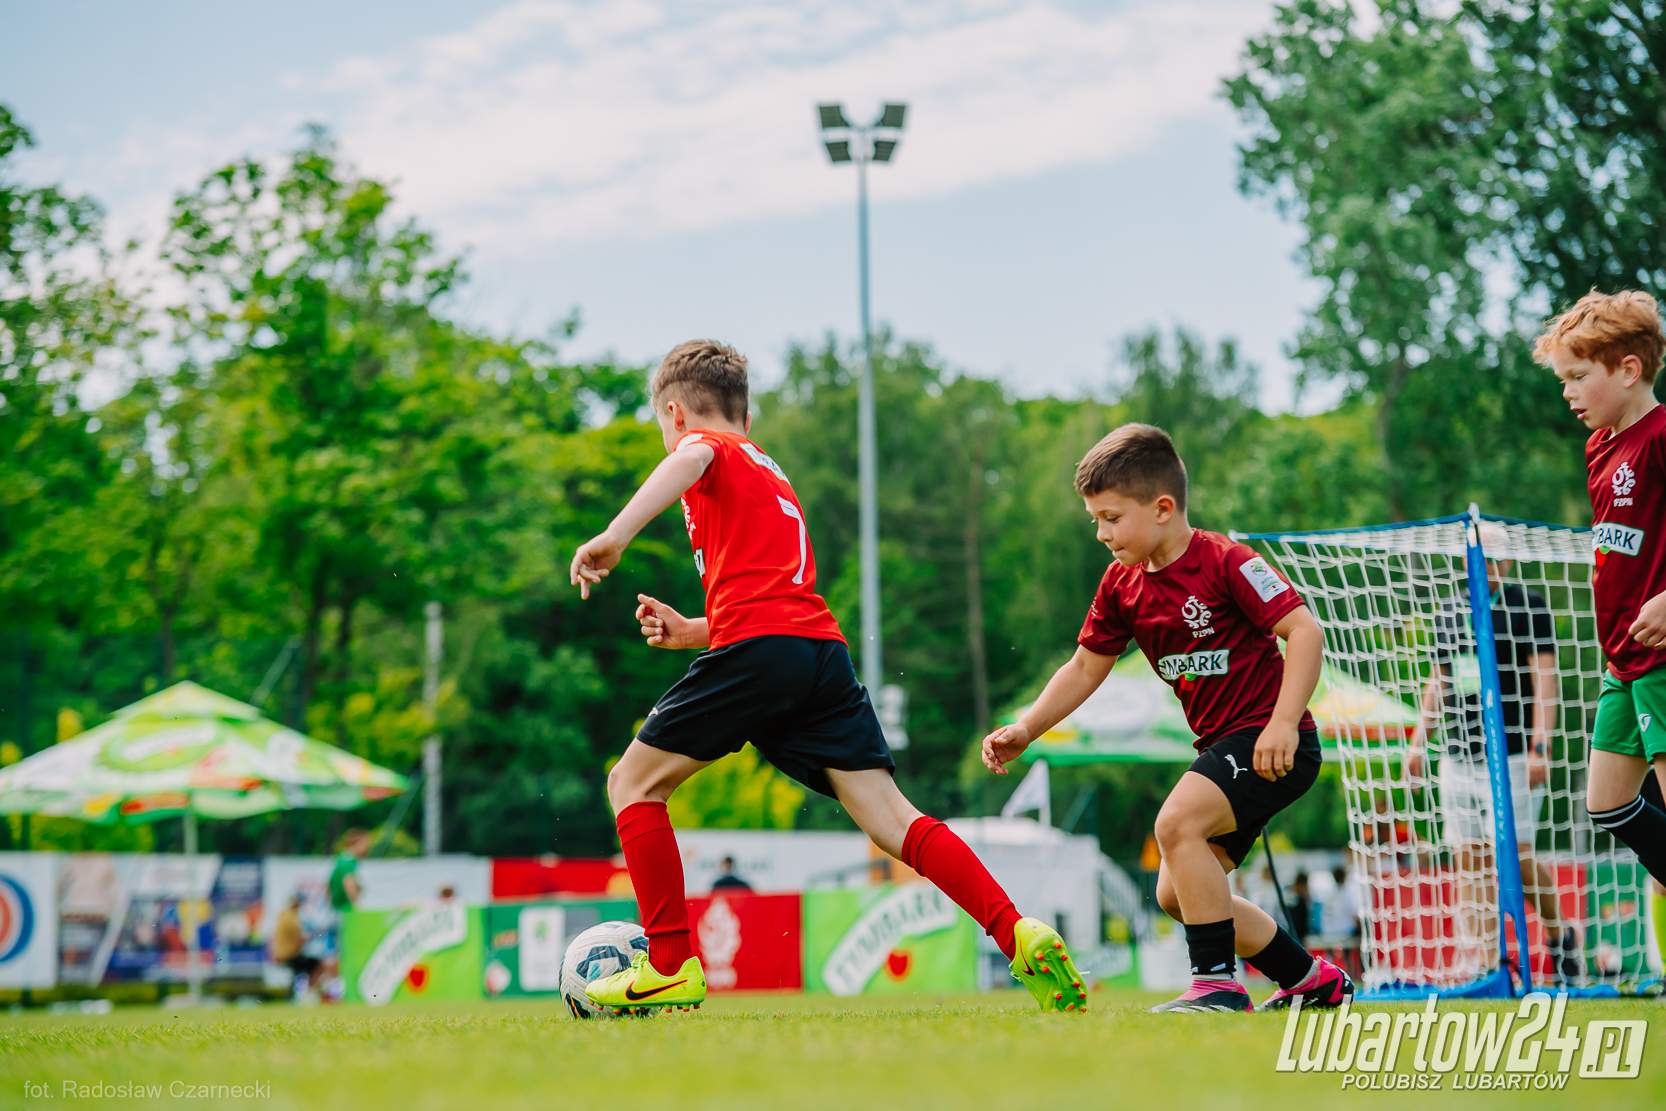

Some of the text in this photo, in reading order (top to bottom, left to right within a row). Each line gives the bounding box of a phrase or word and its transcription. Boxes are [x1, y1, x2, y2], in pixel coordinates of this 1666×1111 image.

[777, 495, 807, 585] 7
[1597, 526, 1637, 551] BARK
[1192, 626, 1216, 639] PZPN
